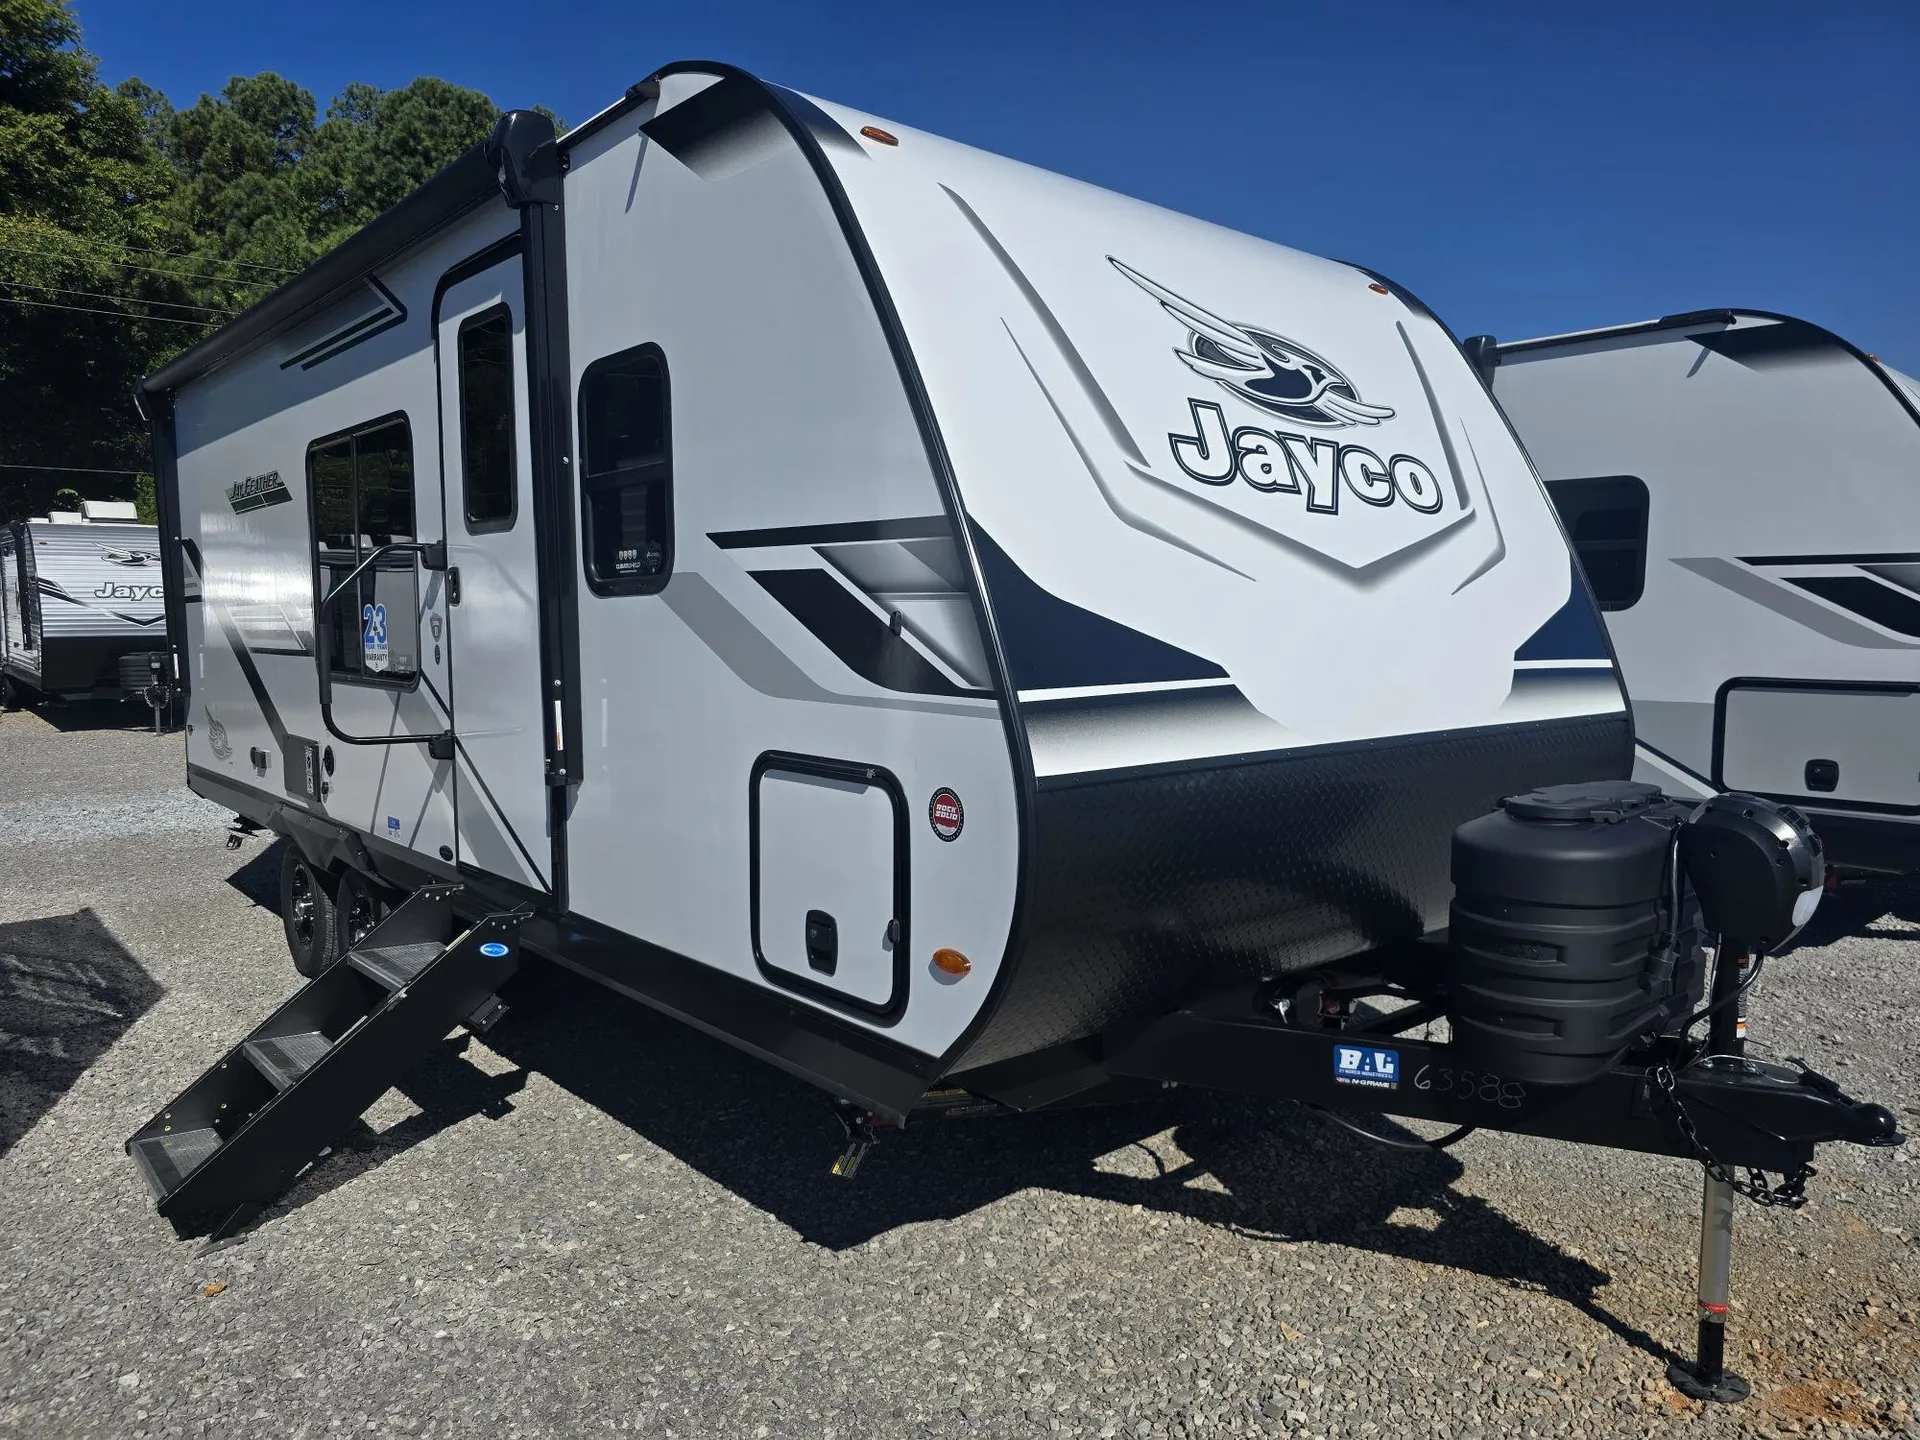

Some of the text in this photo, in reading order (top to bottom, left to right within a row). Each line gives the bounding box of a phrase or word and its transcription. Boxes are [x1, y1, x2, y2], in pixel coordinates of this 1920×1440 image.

[1168, 397, 1443, 516] Jayco
[244, 471, 279, 496] FEATHER
[365, 653, 387, 661] WARRANTY
[935, 811, 958, 821] SOLID
[936, 804, 957, 813] ROCK
[1339, 1049, 1394, 1074] BAL
[1413, 1064, 1526, 1109] 63588
